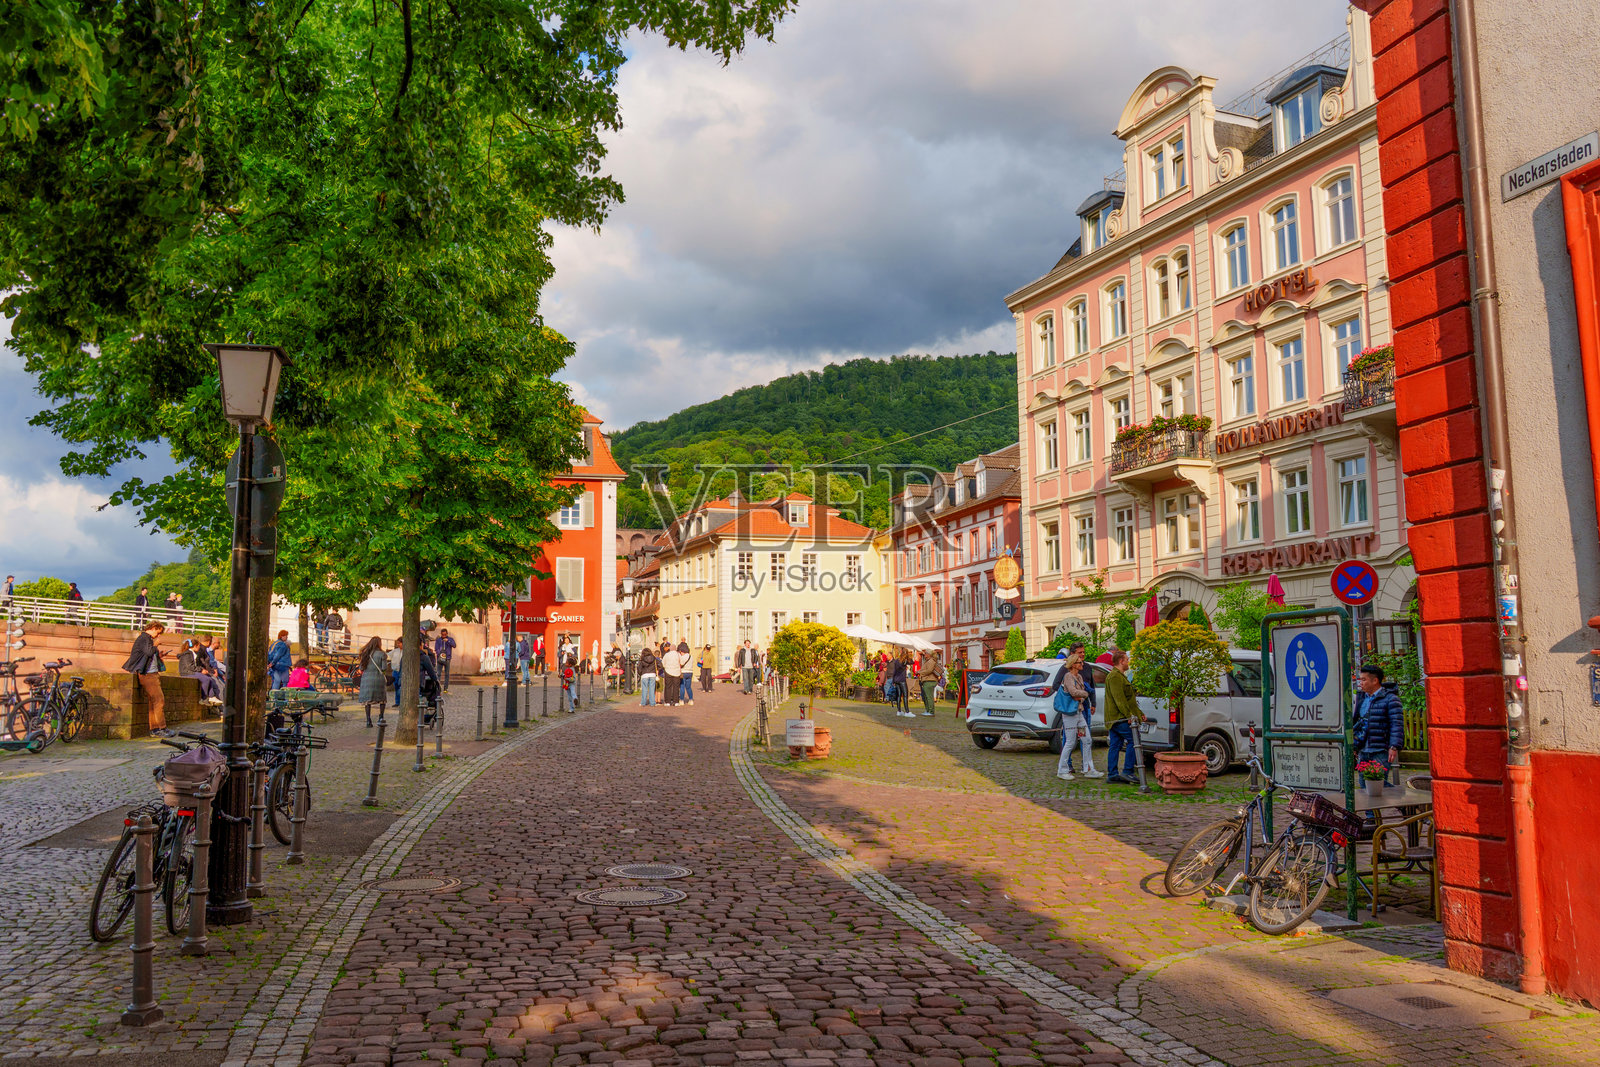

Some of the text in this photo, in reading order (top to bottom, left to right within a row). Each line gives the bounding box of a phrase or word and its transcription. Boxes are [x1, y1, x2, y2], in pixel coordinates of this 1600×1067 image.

[1508, 143, 1592, 192] Neckarstaden
[1244, 266, 1320, 312] HOTEL
[1215, 401, 1346, 454] HOLLÄNDER HO
[1221, 532, 1376, 576] RESTAURANT
[502, 611, 525, 623] DR
[548, 611, 585, 623] SPANIER
[1055, 621, 1091, 641] irtshau
[1290, 704, 1323, 721] ZONE
